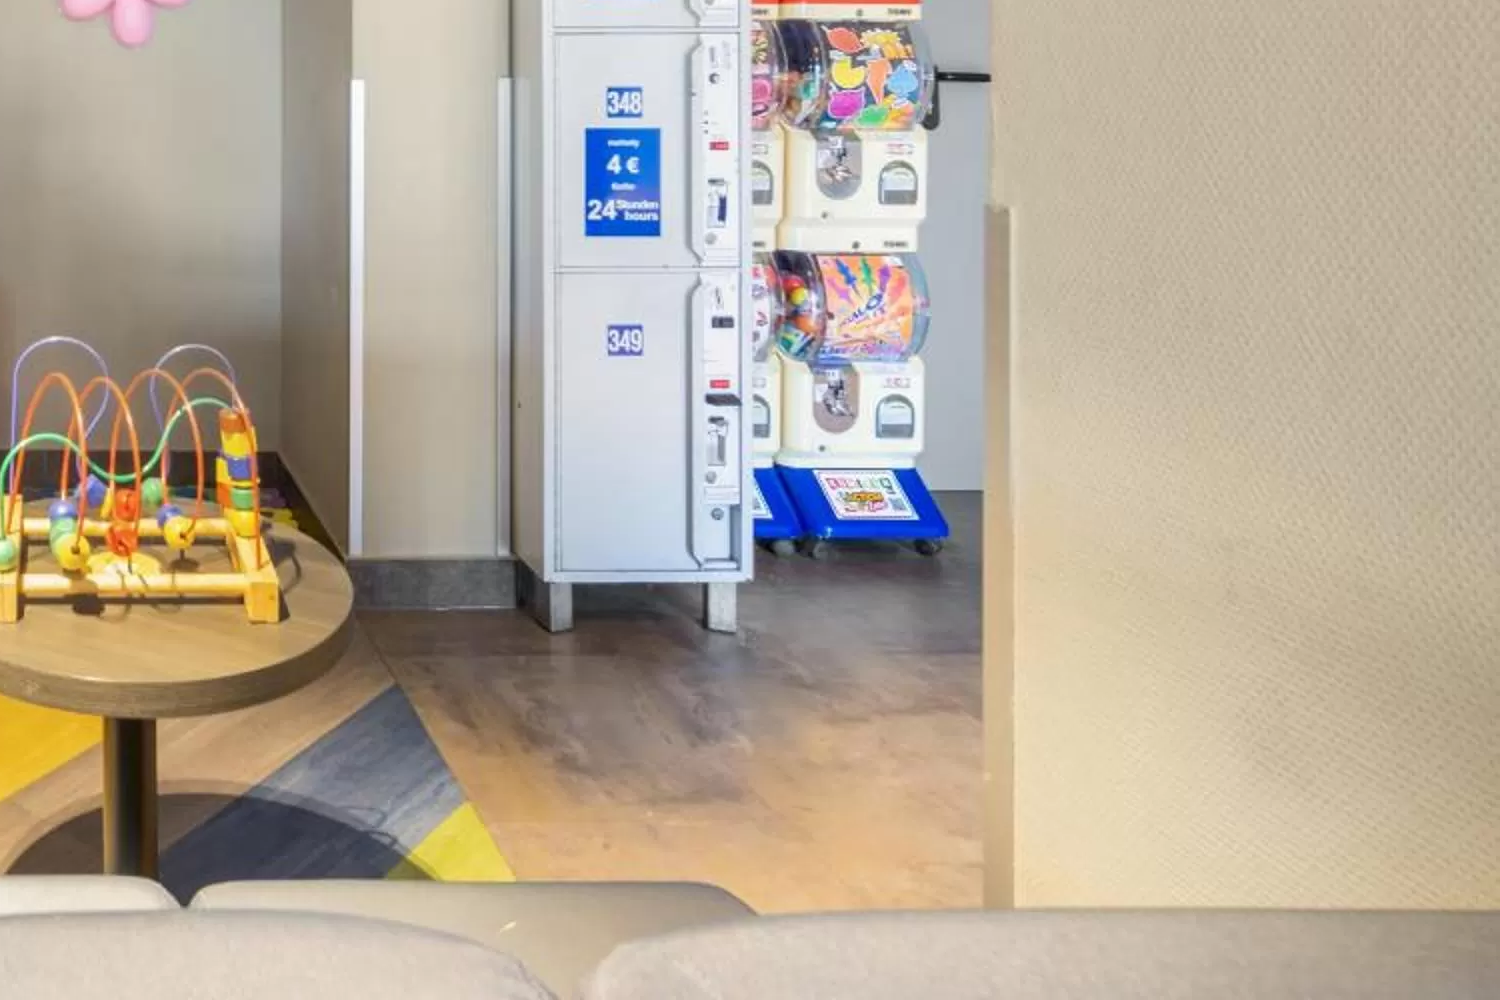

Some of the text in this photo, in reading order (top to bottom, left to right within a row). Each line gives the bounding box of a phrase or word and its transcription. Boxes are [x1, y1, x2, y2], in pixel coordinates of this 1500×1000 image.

[608, 91, 642, 115] 348
[606, 154, 640, 175] 4 €
[587, 200, 617, 221] 24
[609, 330, 642, 353] 349
